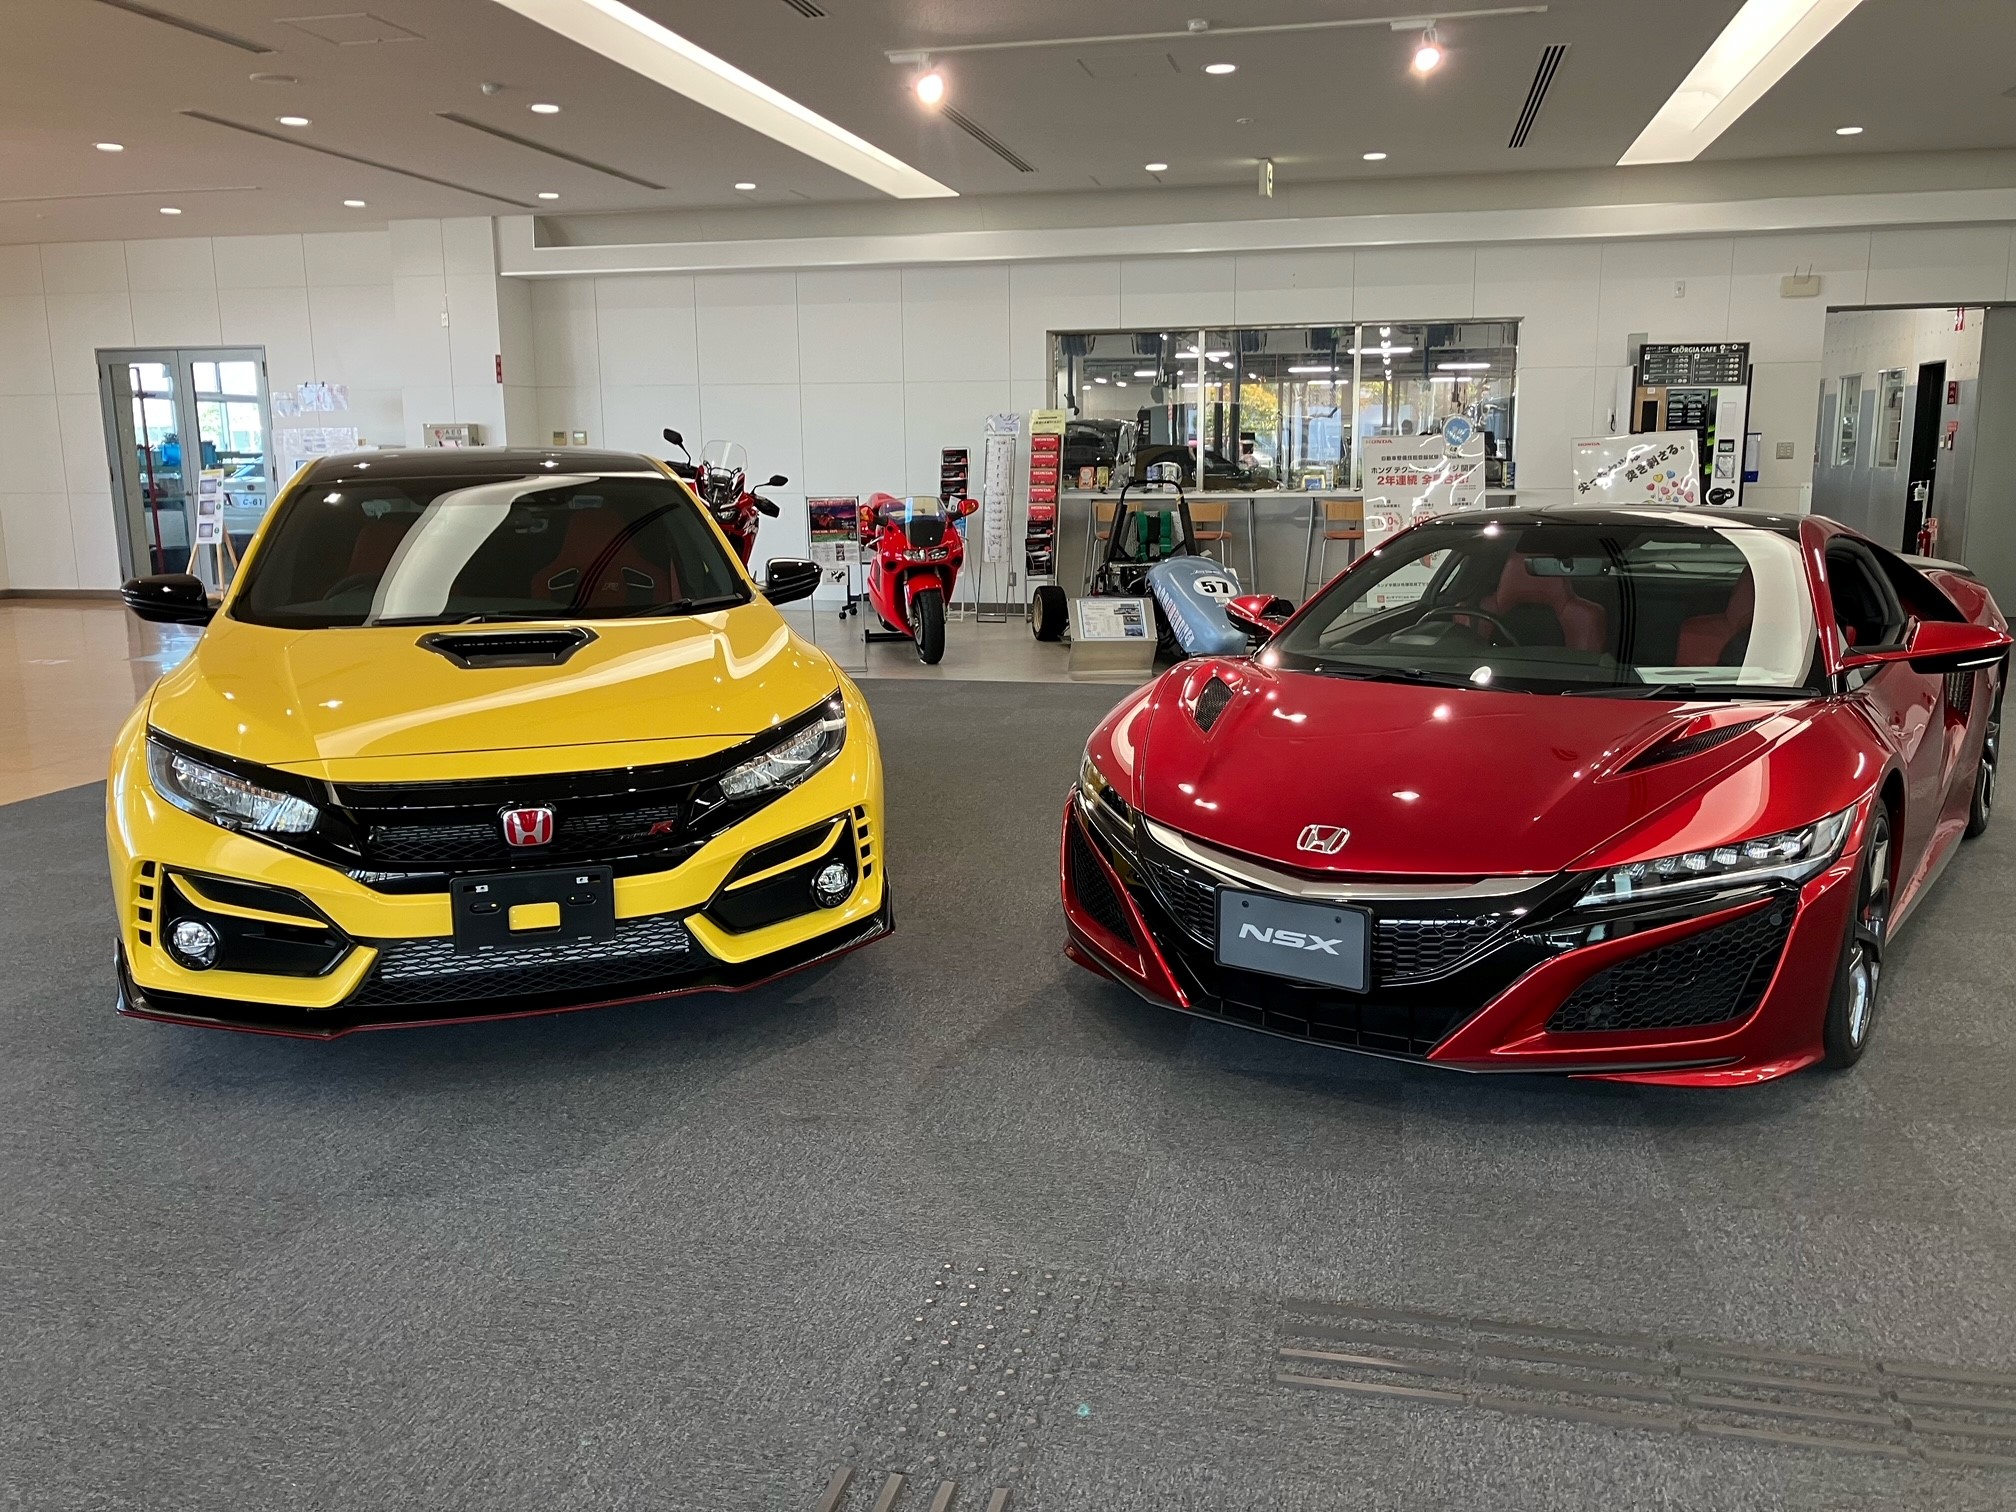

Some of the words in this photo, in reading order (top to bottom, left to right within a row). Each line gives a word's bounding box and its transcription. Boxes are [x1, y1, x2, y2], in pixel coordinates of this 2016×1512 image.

[1671, 345, 1700, 354] GEORGIA
[1377, 475, 1418, 486] 2年連続
[1200, 581, 1229, 594] 57
[1238, 923, 1343, 956] NSX
